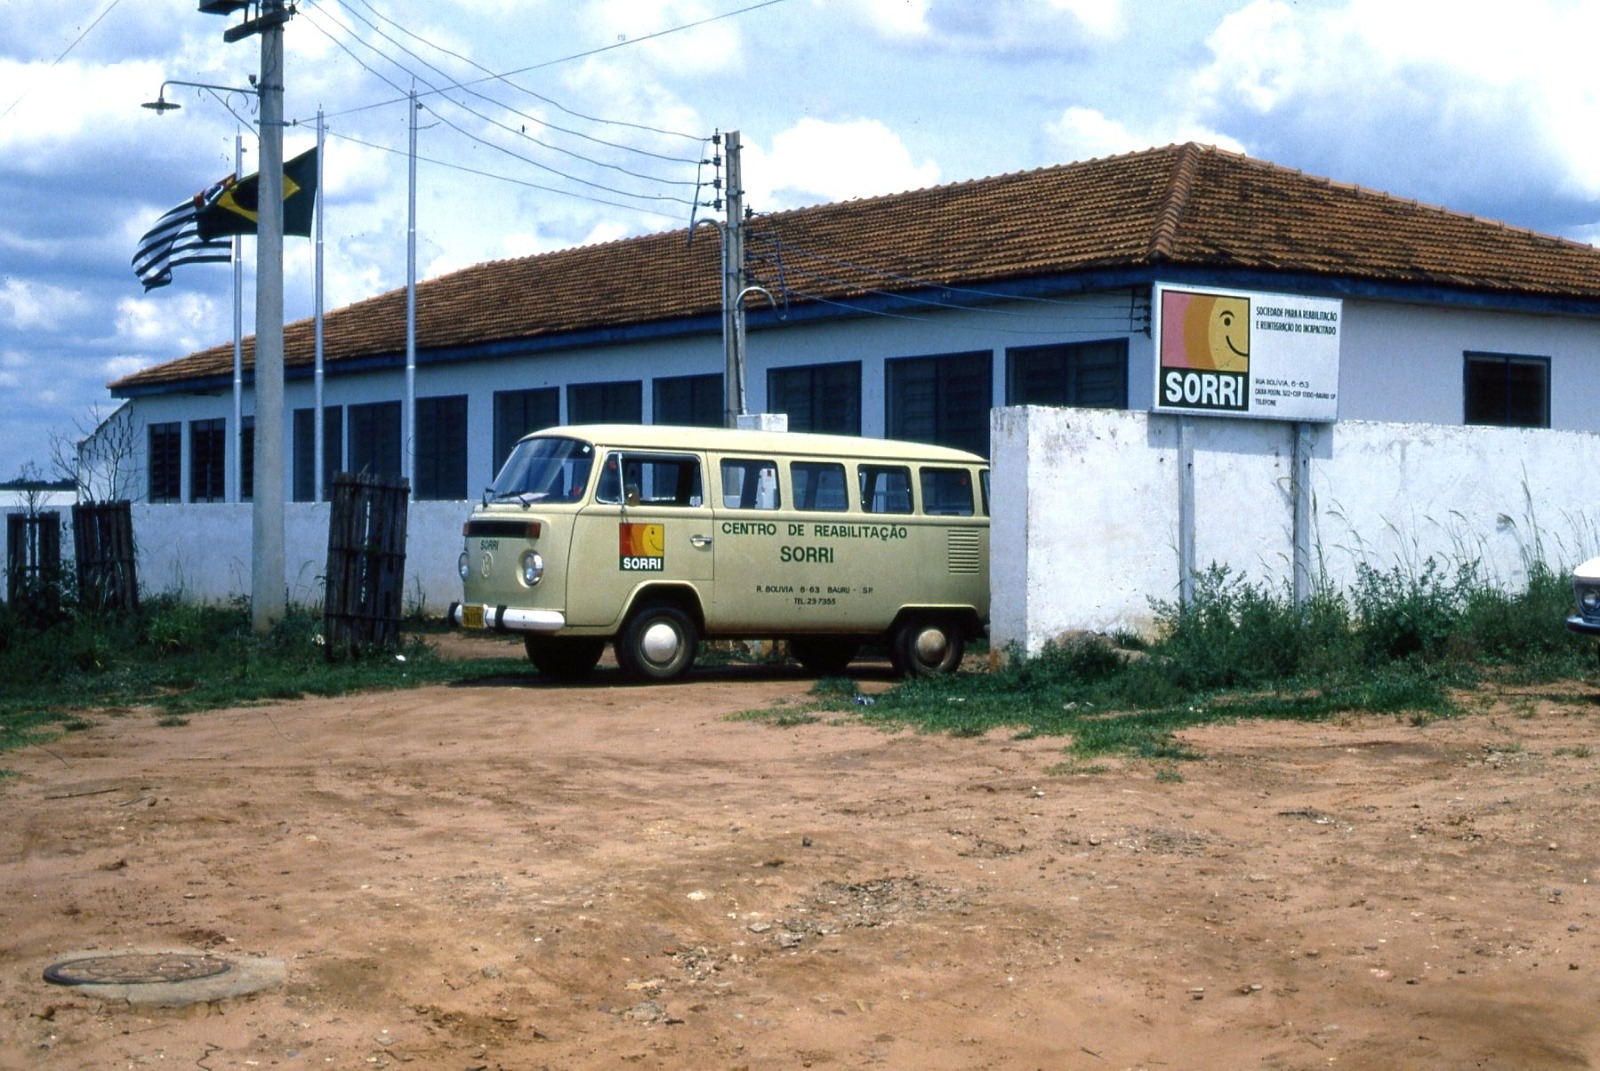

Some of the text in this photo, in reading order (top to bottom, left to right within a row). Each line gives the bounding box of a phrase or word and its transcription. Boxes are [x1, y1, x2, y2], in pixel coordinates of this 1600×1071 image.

[1256, 306, 1283, 317] SOCIEDADE
[1284, 308, 1297, 318] PARA
[1303, 310, 1338, 321] REABILITAÇÃO
[1295, 323, 1302, 333] DO
[1303, 324, 1336, 335] INCAPACITADO
[1165, 371, 1244, 407] SORRI
[1255, 398, 1277, 406] TELEFONE
[721, 522, 908, 541] CENTRO DE REABILITAÇÃO
[480, 539, 499, 550] SORRI
[780, 546, 834, 563] SORRI
[622, 557, 662, 570] SORRI
